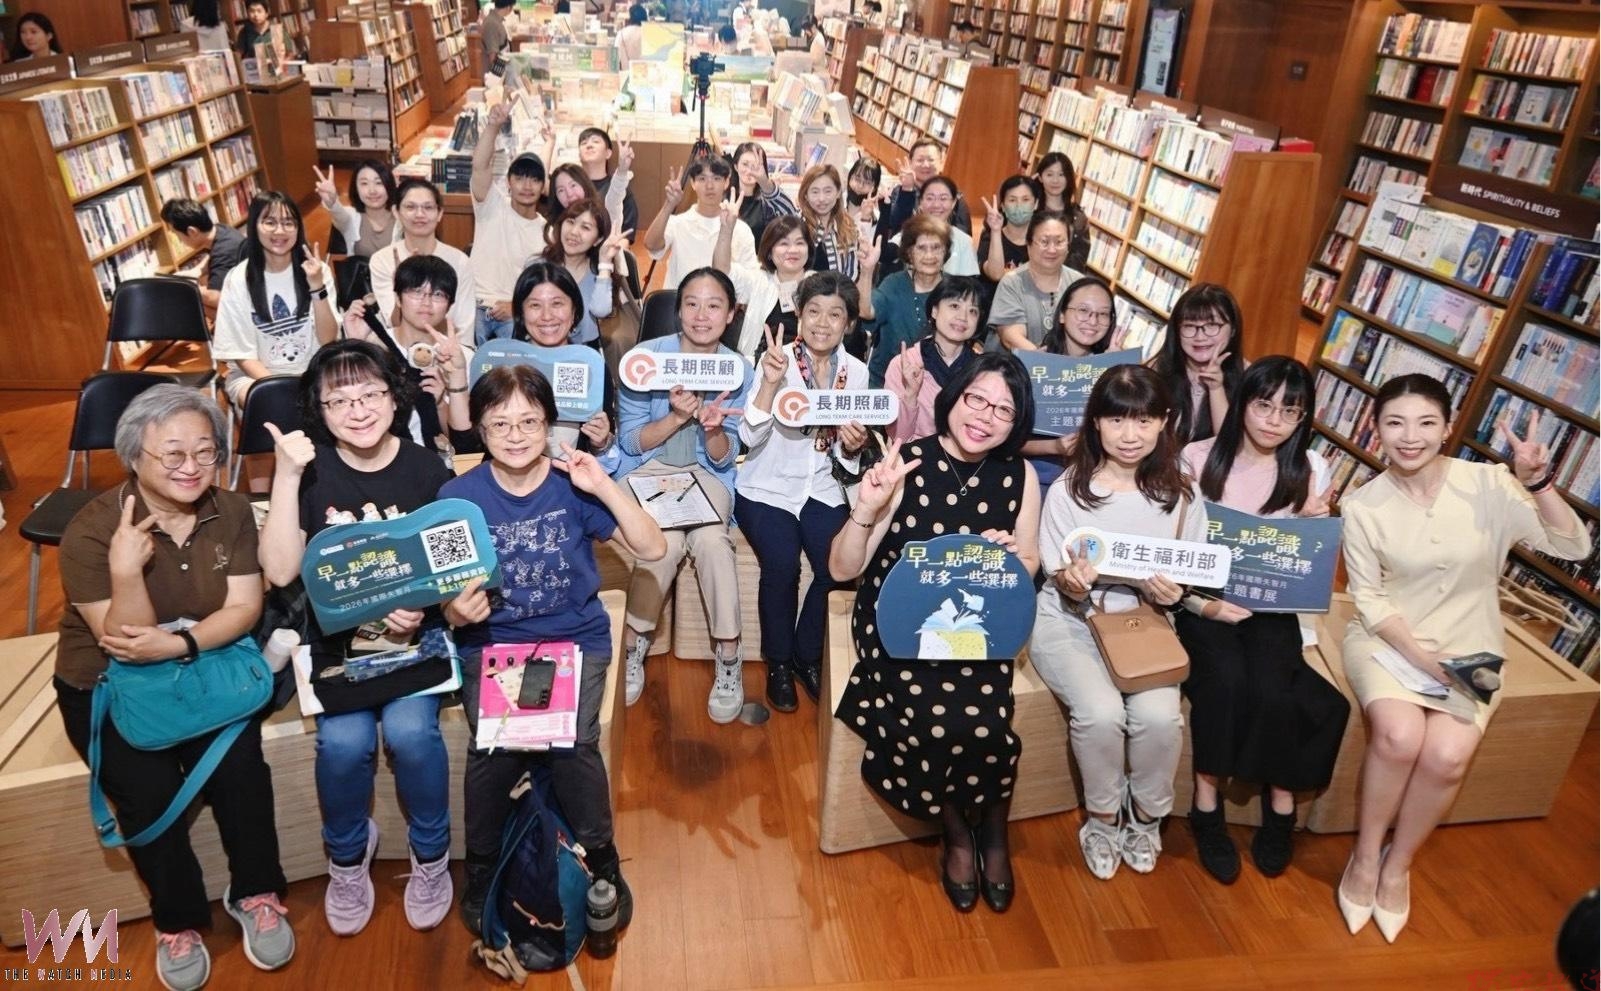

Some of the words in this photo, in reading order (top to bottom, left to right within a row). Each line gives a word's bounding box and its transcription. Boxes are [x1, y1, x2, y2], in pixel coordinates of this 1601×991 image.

[1483, 191, 1524, 208] SPIRITUALITY
[1531, 204, 1561, 219] BELIEFS
[662, 358, 735, 376] 長期照顧
[816, 395, 890, 411] 長期照顧
[1207, 520, 1301, 557] 早一點認識
[317, 549, 399, 582] 早一點認識
[906, 544, 1006, 572] 早一點認識
[1112, 541, 1217, 570] 衛生福利部
[1219, 544, 1312, 575] 多一些選擇
[334, 562, 413, 591] 就多一些選擇
[919, 569, 1018, 589] 就多一些選擇
[1109, 561, 1136, 572] Ministry
[1187, 570, 1214, 579] Welfare
